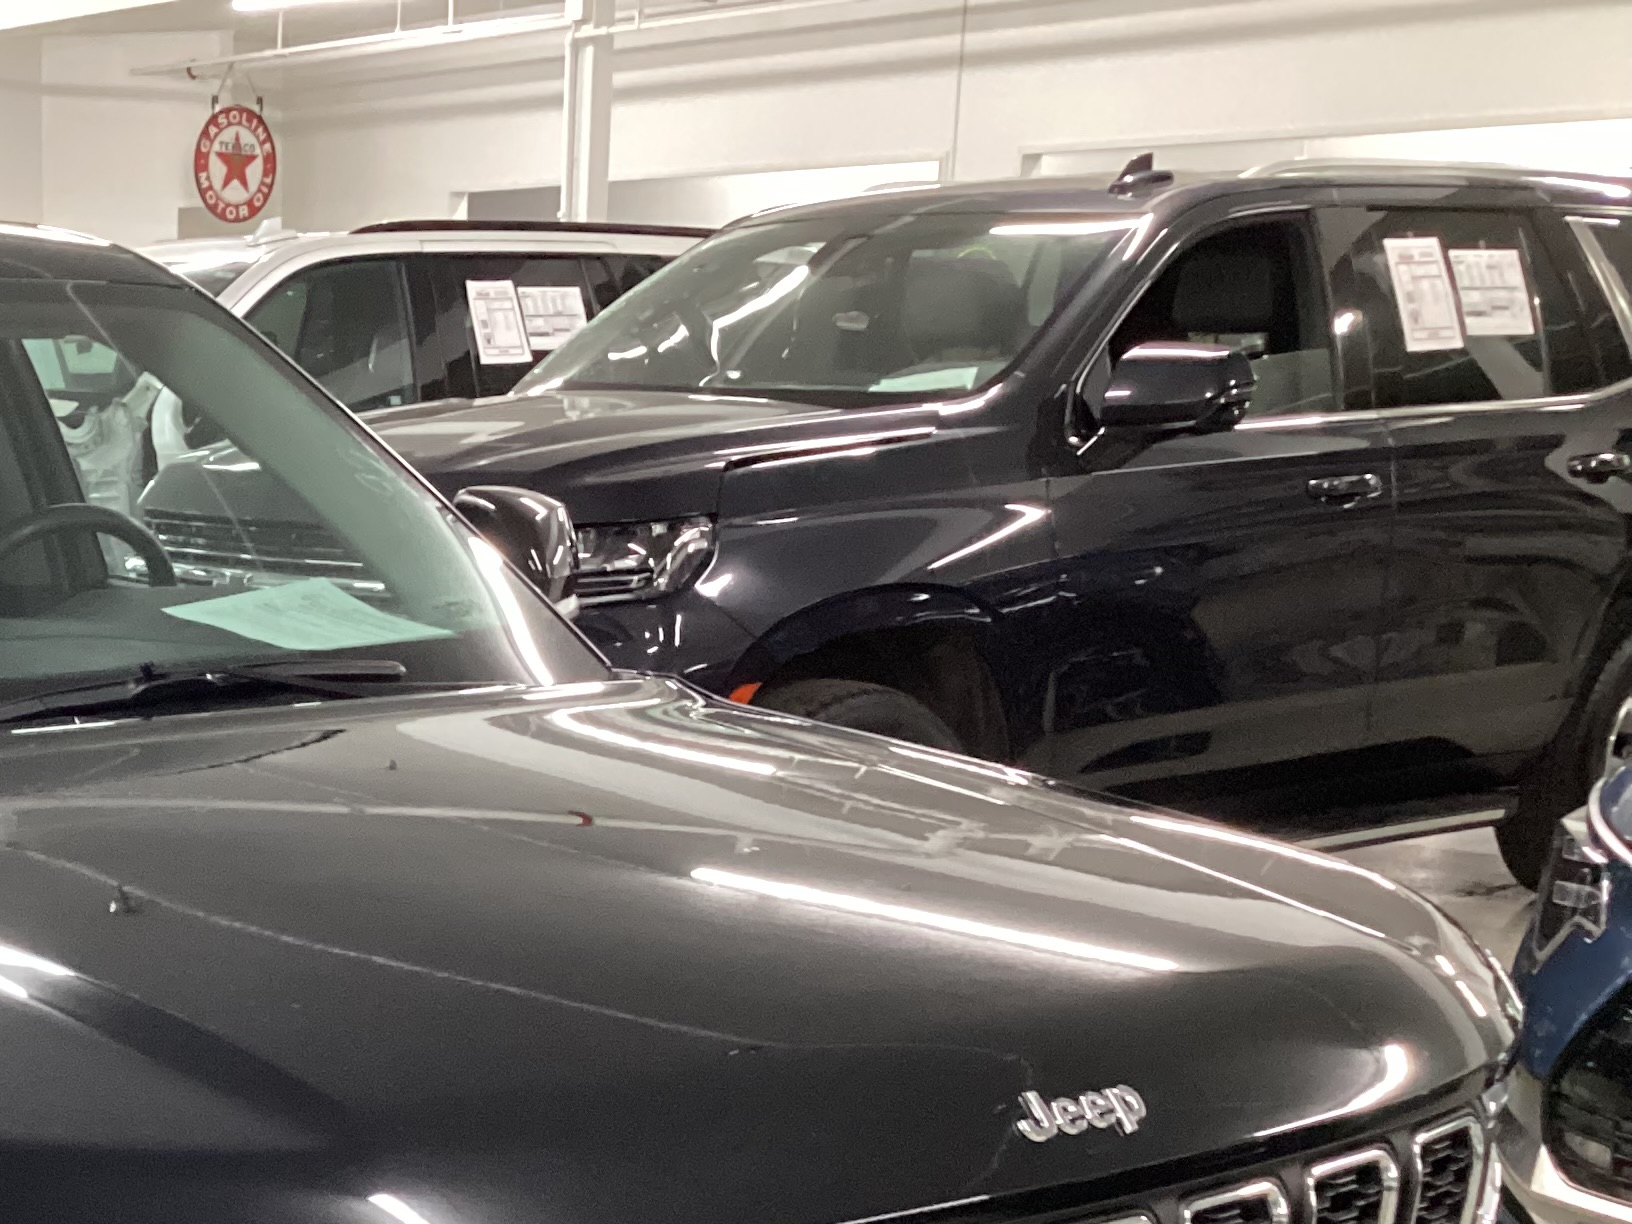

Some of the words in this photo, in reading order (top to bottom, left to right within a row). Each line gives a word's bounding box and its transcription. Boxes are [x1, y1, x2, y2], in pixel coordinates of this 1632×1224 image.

[200, 110, 273, 156] GASOLINE
[219, 141, 256, 154] TEXACO
[198, 171, 249, 219] MOTOR
[253, 173, 273, 207] OIL
[1016, 1083, 1148, 1143] Jeep
